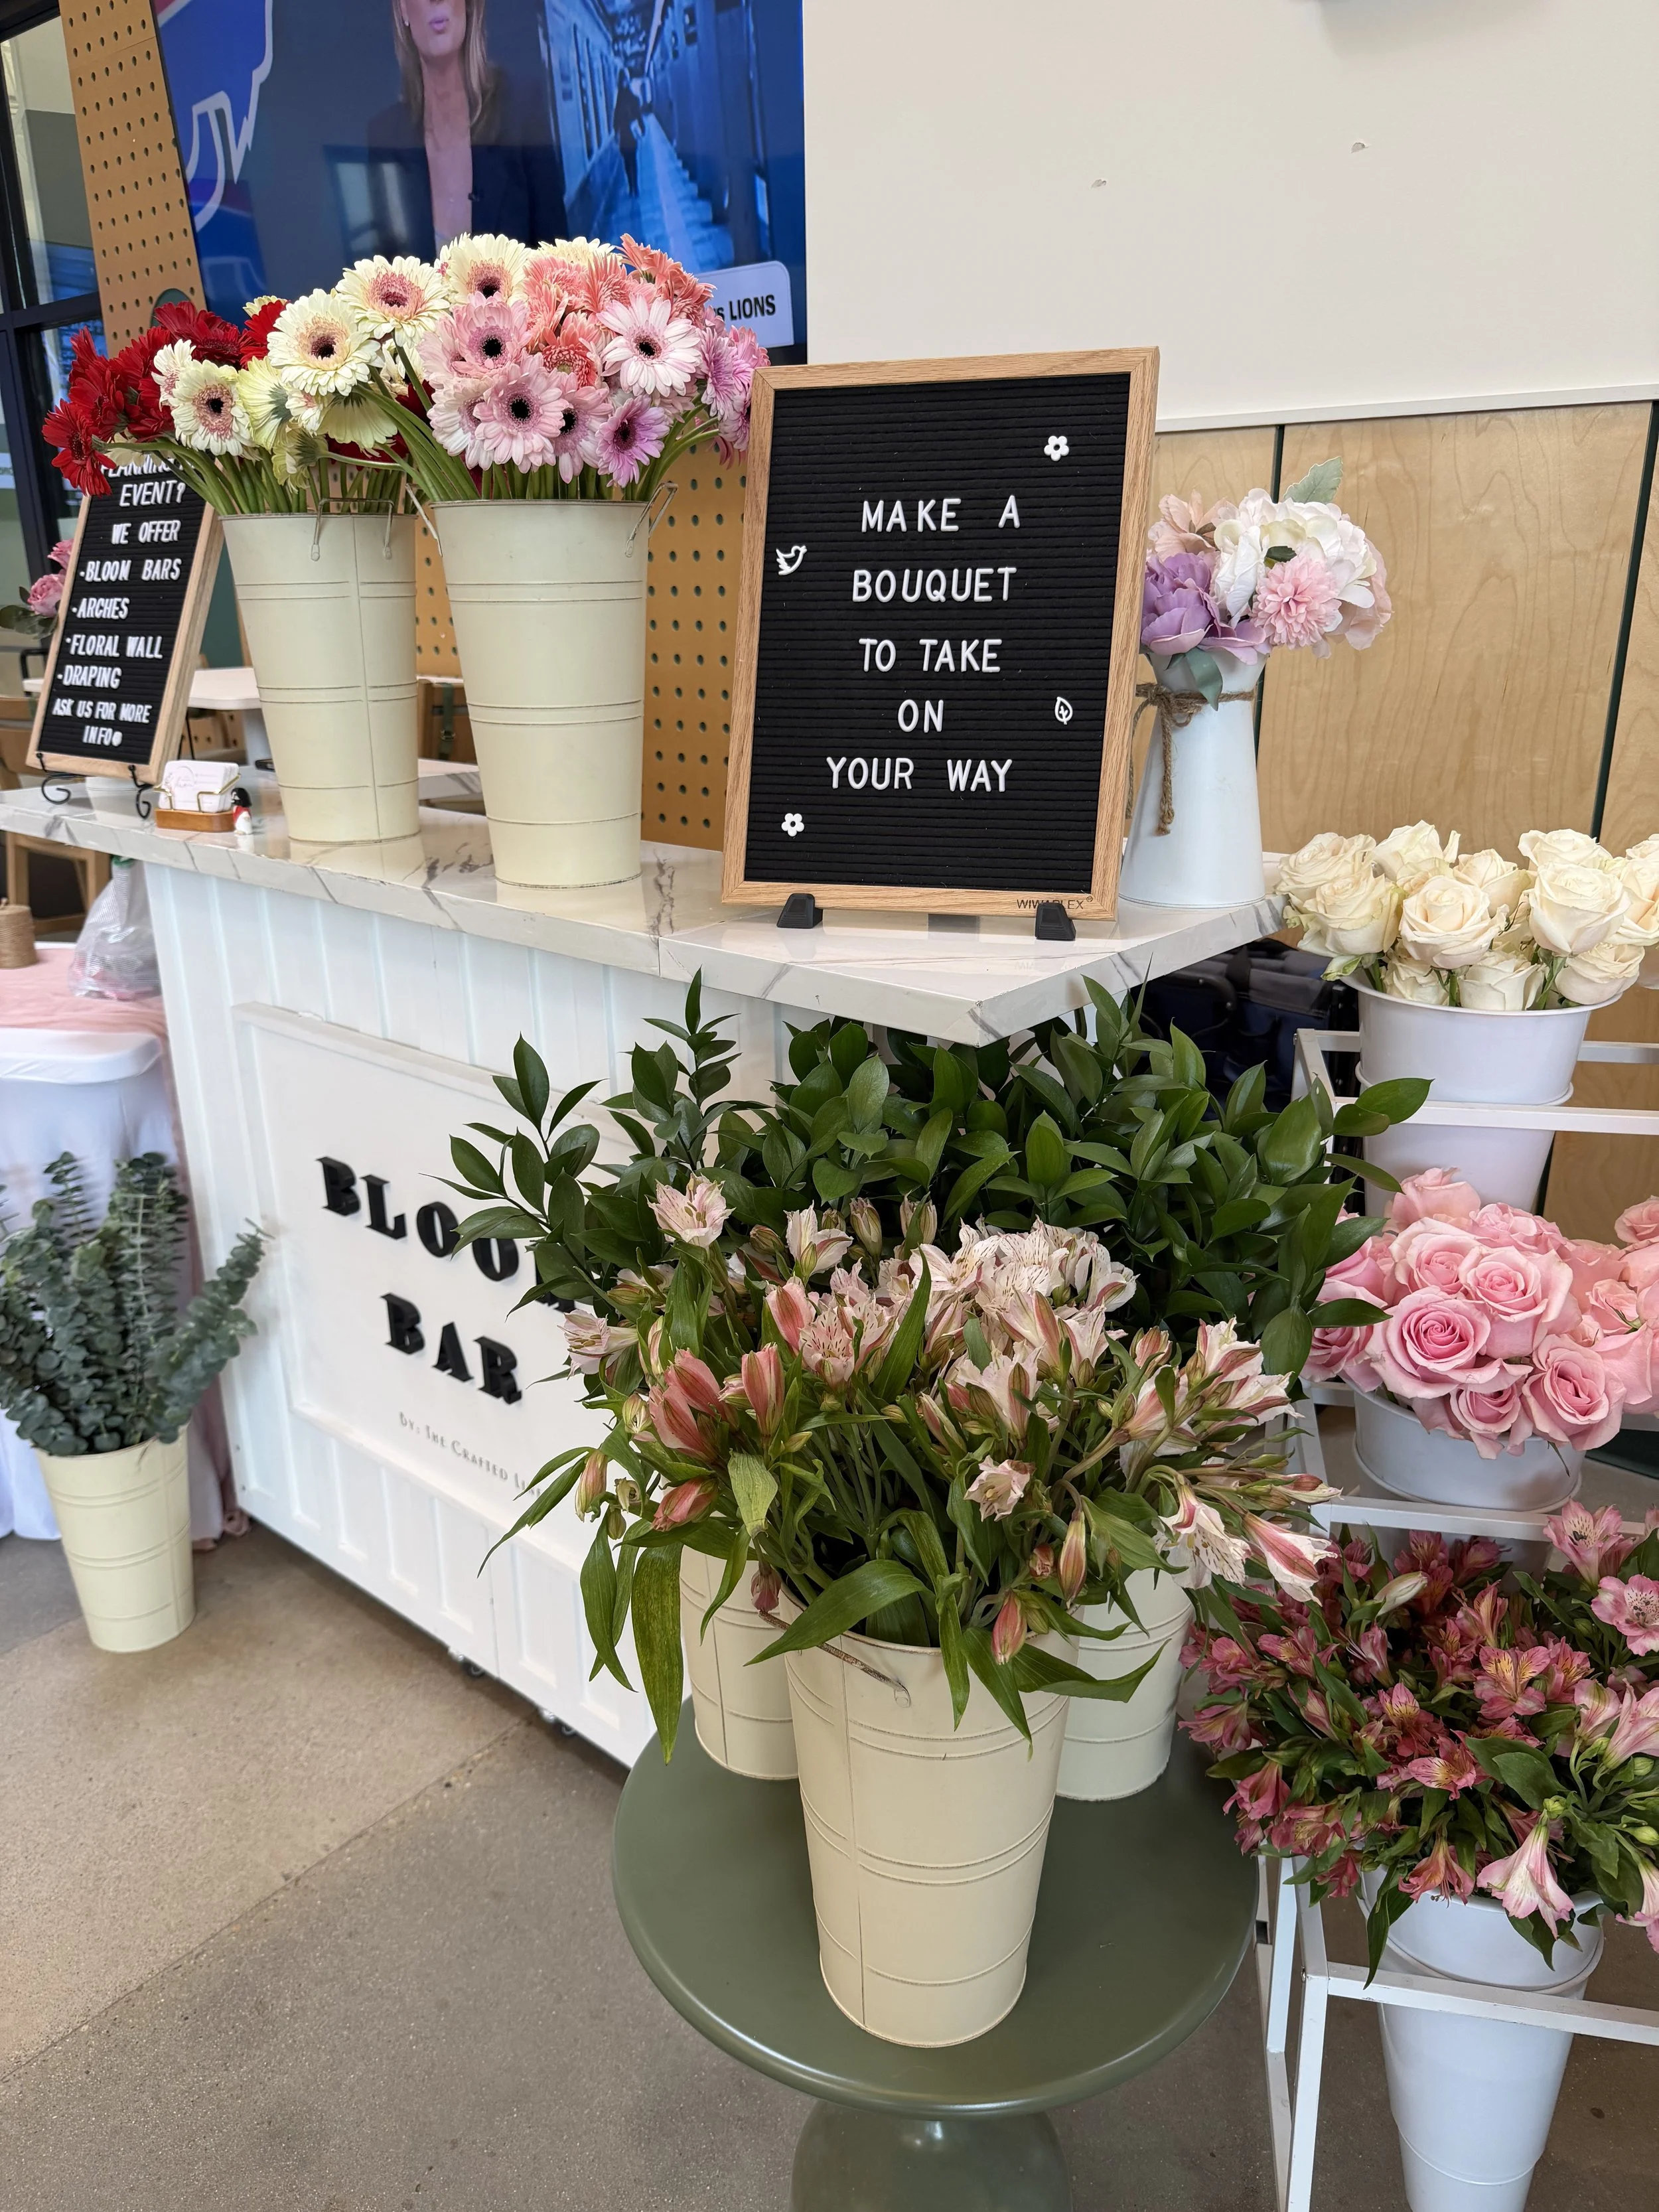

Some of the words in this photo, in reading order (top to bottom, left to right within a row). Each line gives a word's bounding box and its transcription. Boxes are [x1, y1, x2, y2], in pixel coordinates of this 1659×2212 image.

[729, 294, 776, 321] LIONS
[119, 480, 186, 507] EVENT?
[861, 498, 962, 532] MAKE
[998, 494, 1020, 529] A
[111, 523, 131, 545] WE
[138, 520, 181, 544] OFFER
[141, 558, 182, 581] BARS
[852, 567, 1017, 603] BOUQUET
[125, 636, 163, 659] WALL
[858, 638, 897, 672] TO
[919, 638, 1002, 673] TAKE
[52, 698, 74, 717] ASK
[76, 700, 94, 718] US
[94, 701, 117, 720] FOR
[119, 703, 153, 724] MORE
[897, 699, 944, 733] ON
[826, 757, 914, 790] YOUR
[946, 759, 1013, 792] WAY
[315, 1155, 576, 1313] BLOO
[380, 1291, 523, 1405] BAR
